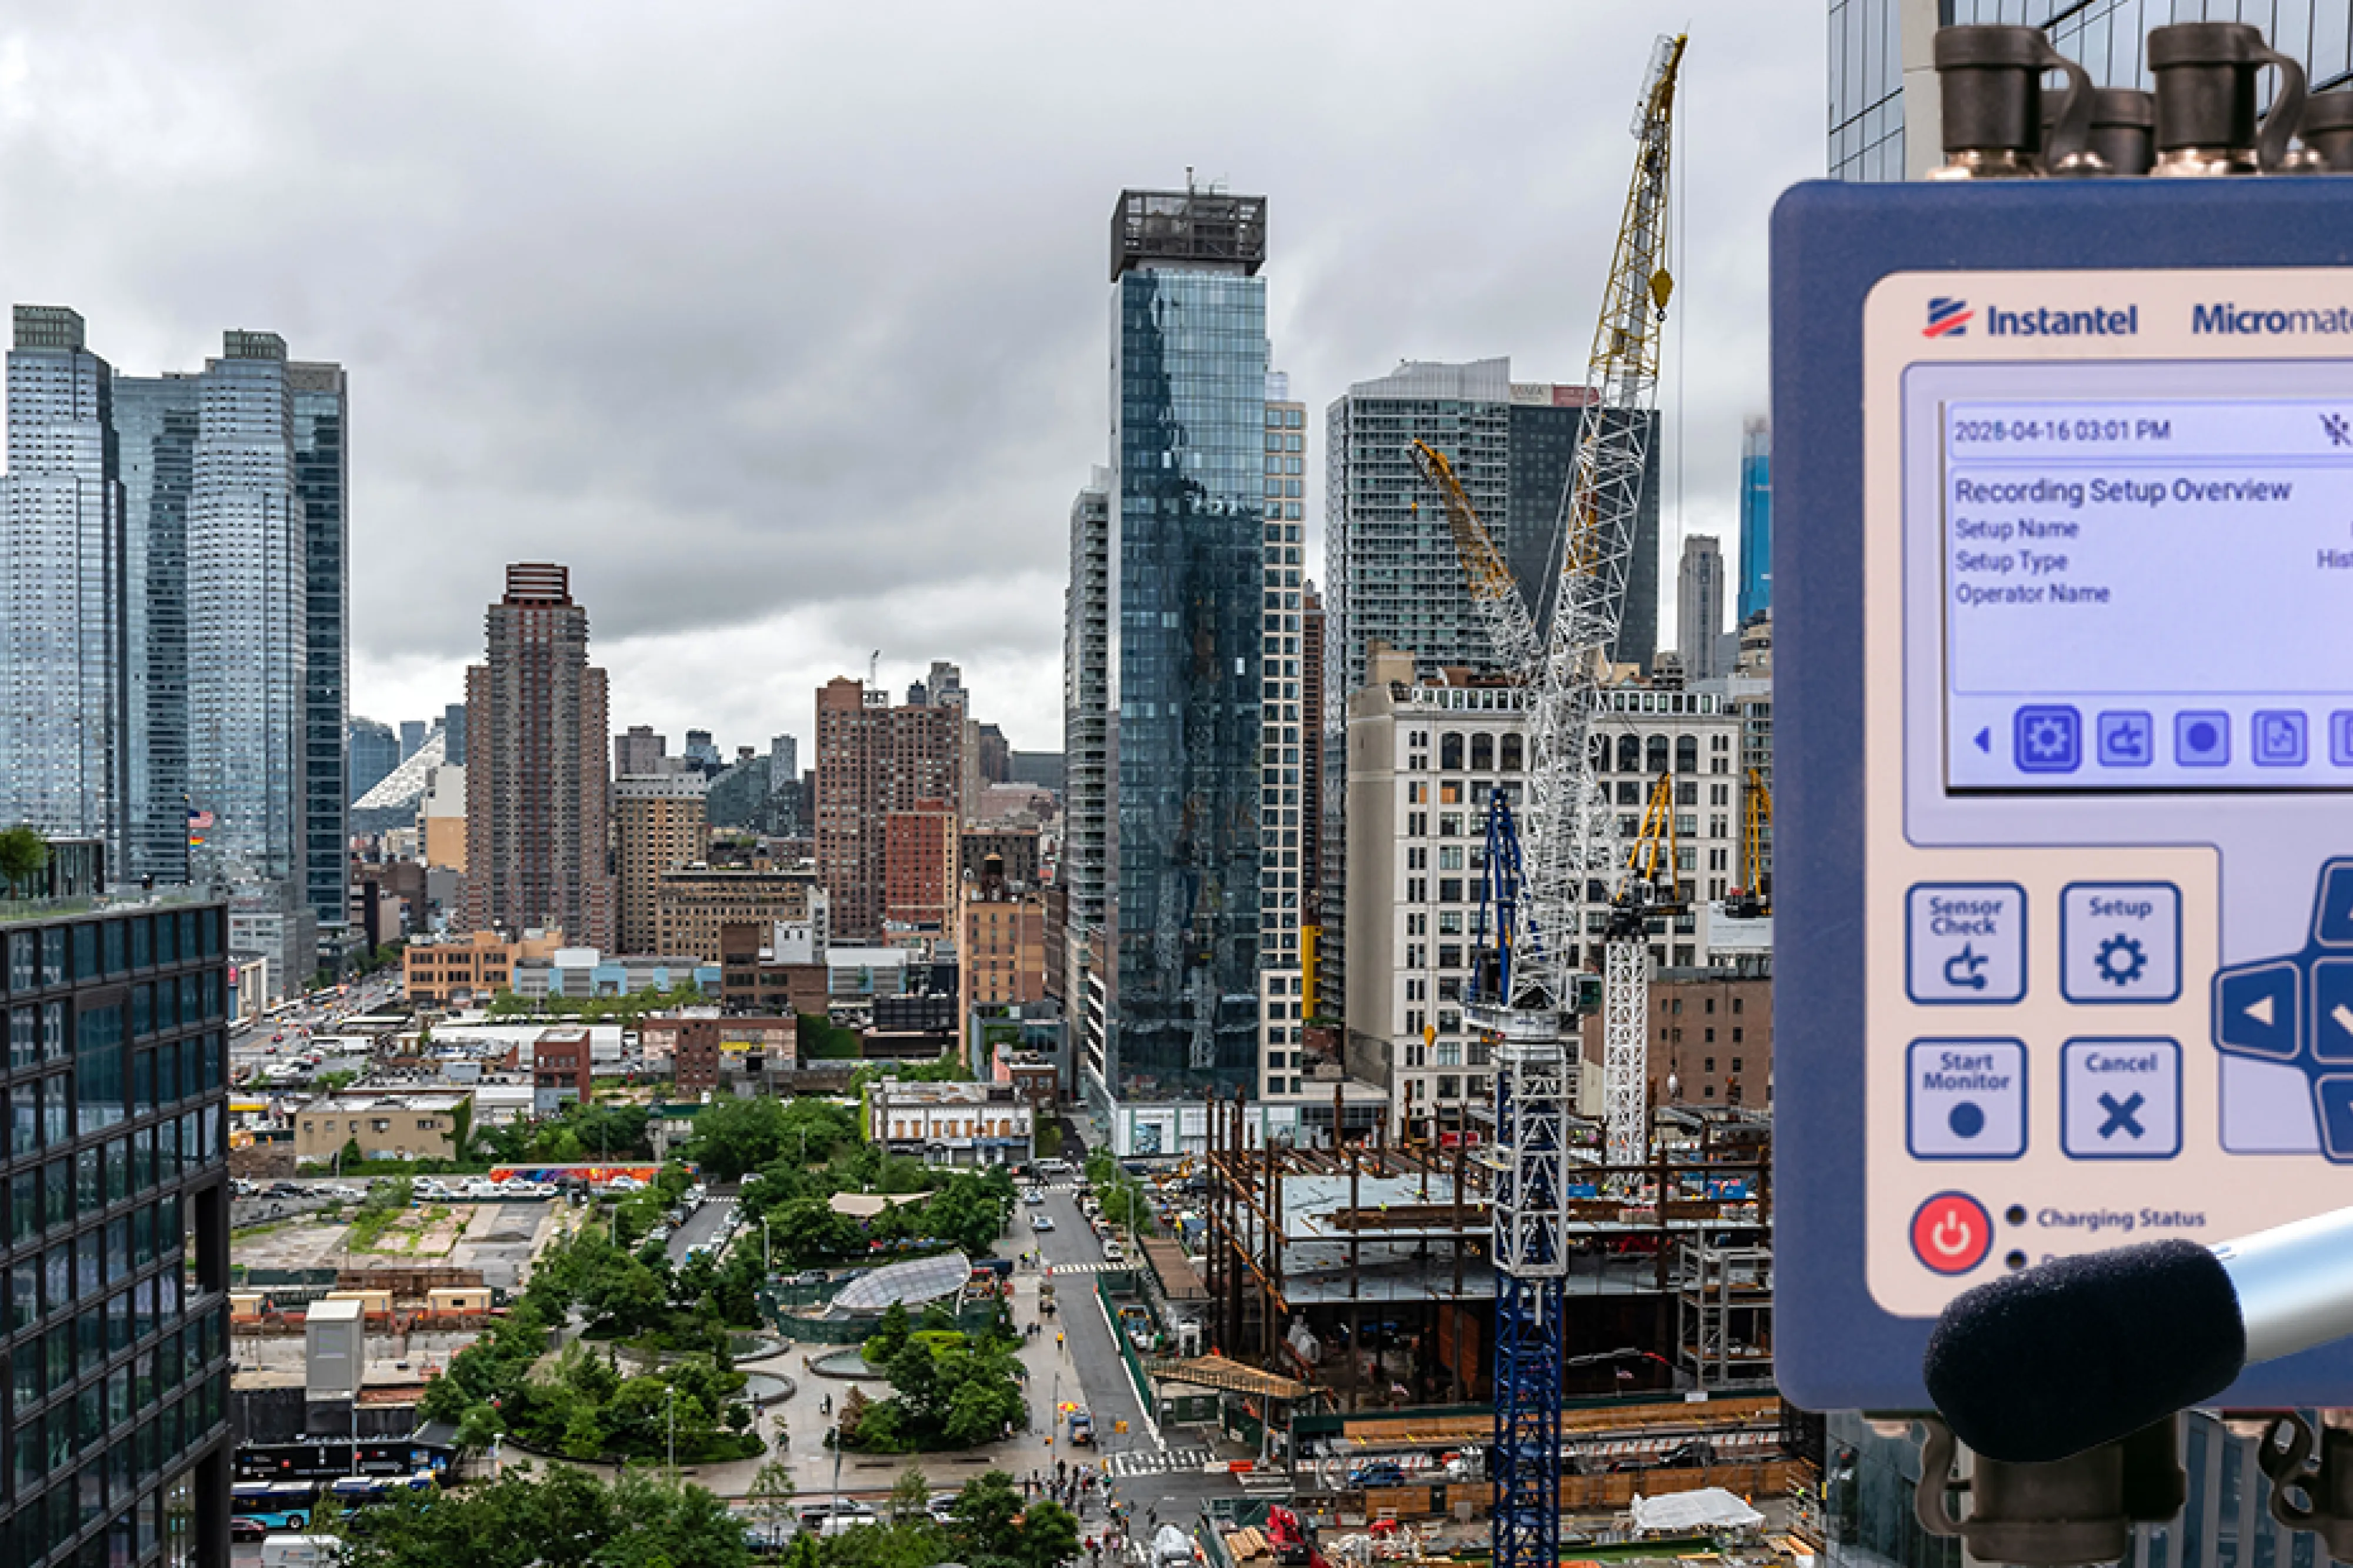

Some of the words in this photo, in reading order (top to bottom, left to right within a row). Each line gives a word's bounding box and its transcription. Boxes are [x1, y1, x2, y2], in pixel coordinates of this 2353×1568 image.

[1988, 303, 2138, 336] Instantel
[2192, 301, 2353, 334] Micromat
[2077, 420, 2128, 441] 03:01
[2135, 420, 2171, 441] PM
[1955, 478, 2085, 508] Recording
[2090, 478, 2167, 508] Setup
[2172, 478, 2292, 502] Overview
[1955, 518, 2014, 542] Setup
[2018, 518, 2079, 539] Name
[1955, 549, 2014, 574] Setup
[2019, 549, 2068, 575] Type
[1955, 583, 2044, 606] Operator
[2049, 583, 2111, 603] Name
[1929, 896, 2003, 916] Sensor
[2089, 896, 2153, 920] Setup
[1930, 918, 1996, 936] Check
[1941, 1052, 1994, 1070] Start
[2085, 1052, 2158, 1072] Cancel
[1923, 1072, 2011, 1090] Monitor
[2037, 1207, 2135, 1234] Charging
[2140, 1207, 2207, 1227] Status
